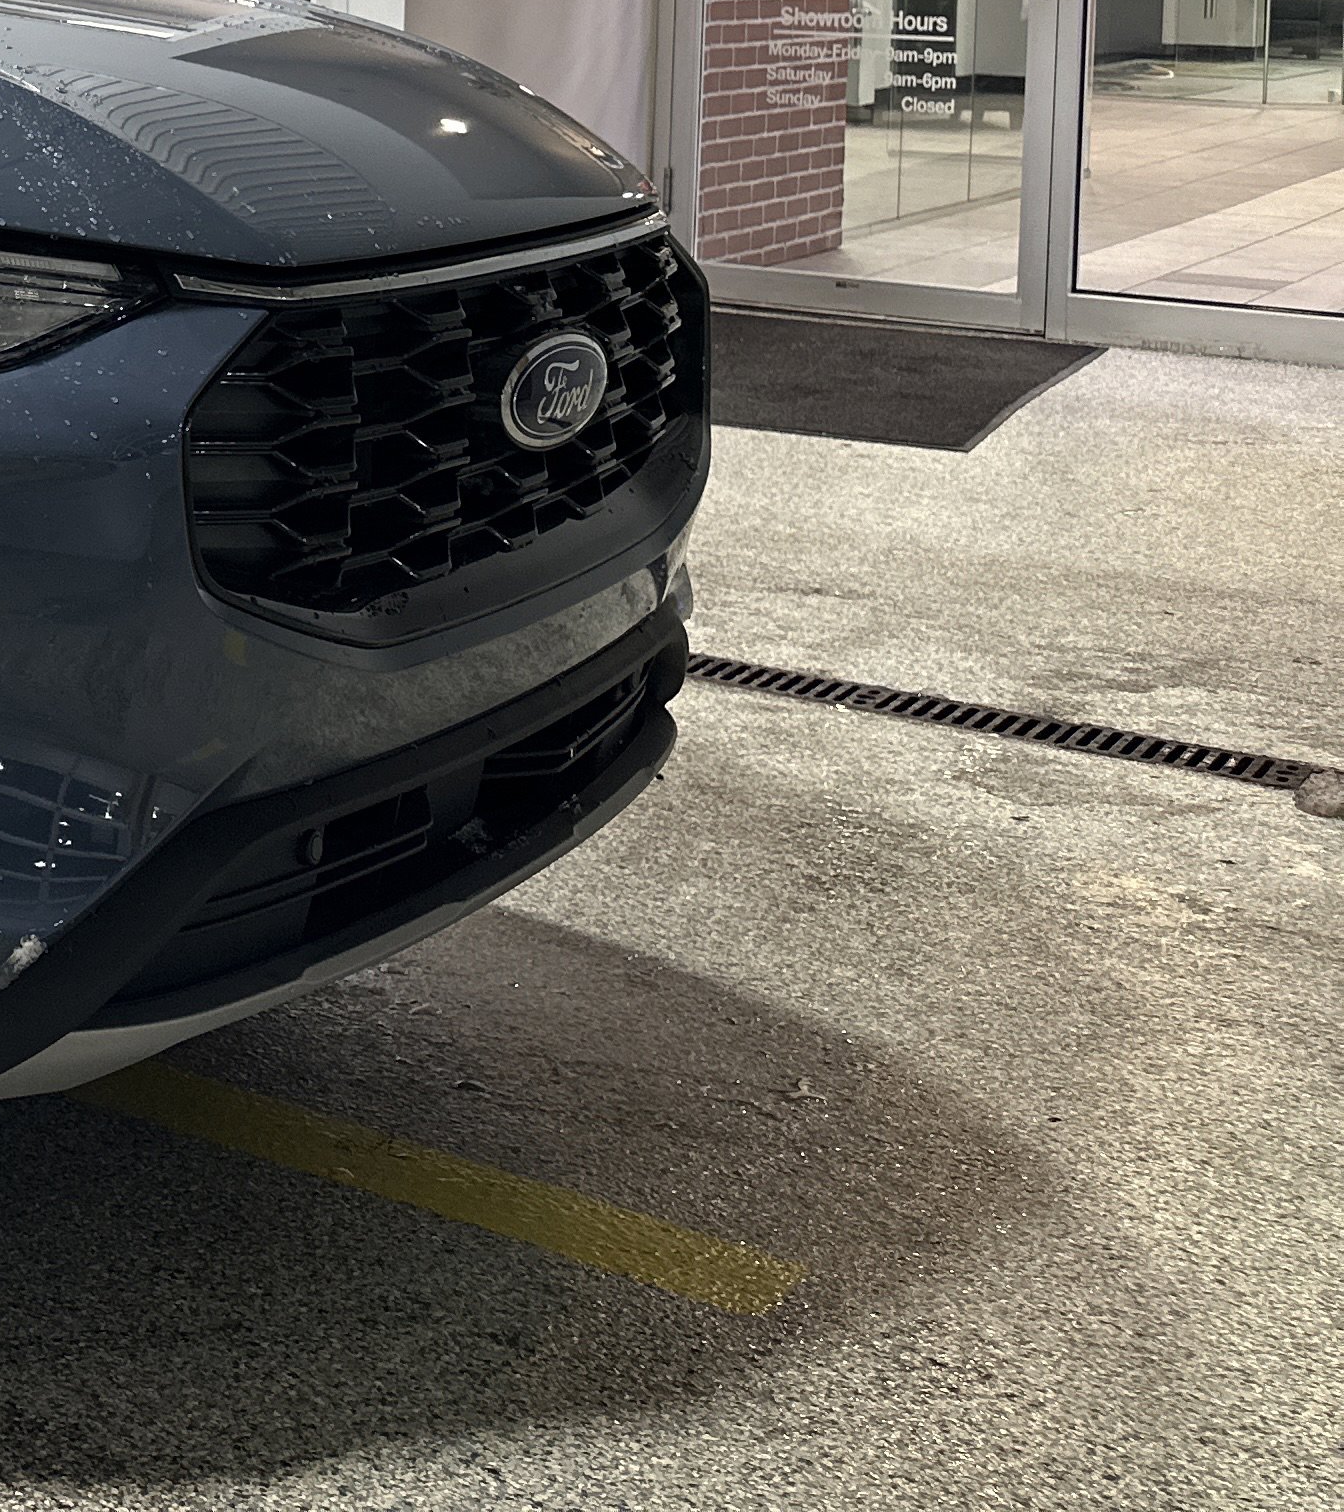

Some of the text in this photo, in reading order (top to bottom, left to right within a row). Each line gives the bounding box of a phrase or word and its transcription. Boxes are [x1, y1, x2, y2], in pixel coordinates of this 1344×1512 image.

[891, 10, 949, 33] Hours
[768, 42, 879, 61] Monday-Frid
[766, 67, 832, 83] Saturday
[766, 89, 955, 114] Sunday Closed
[537, 359, 594, 425] Ford
